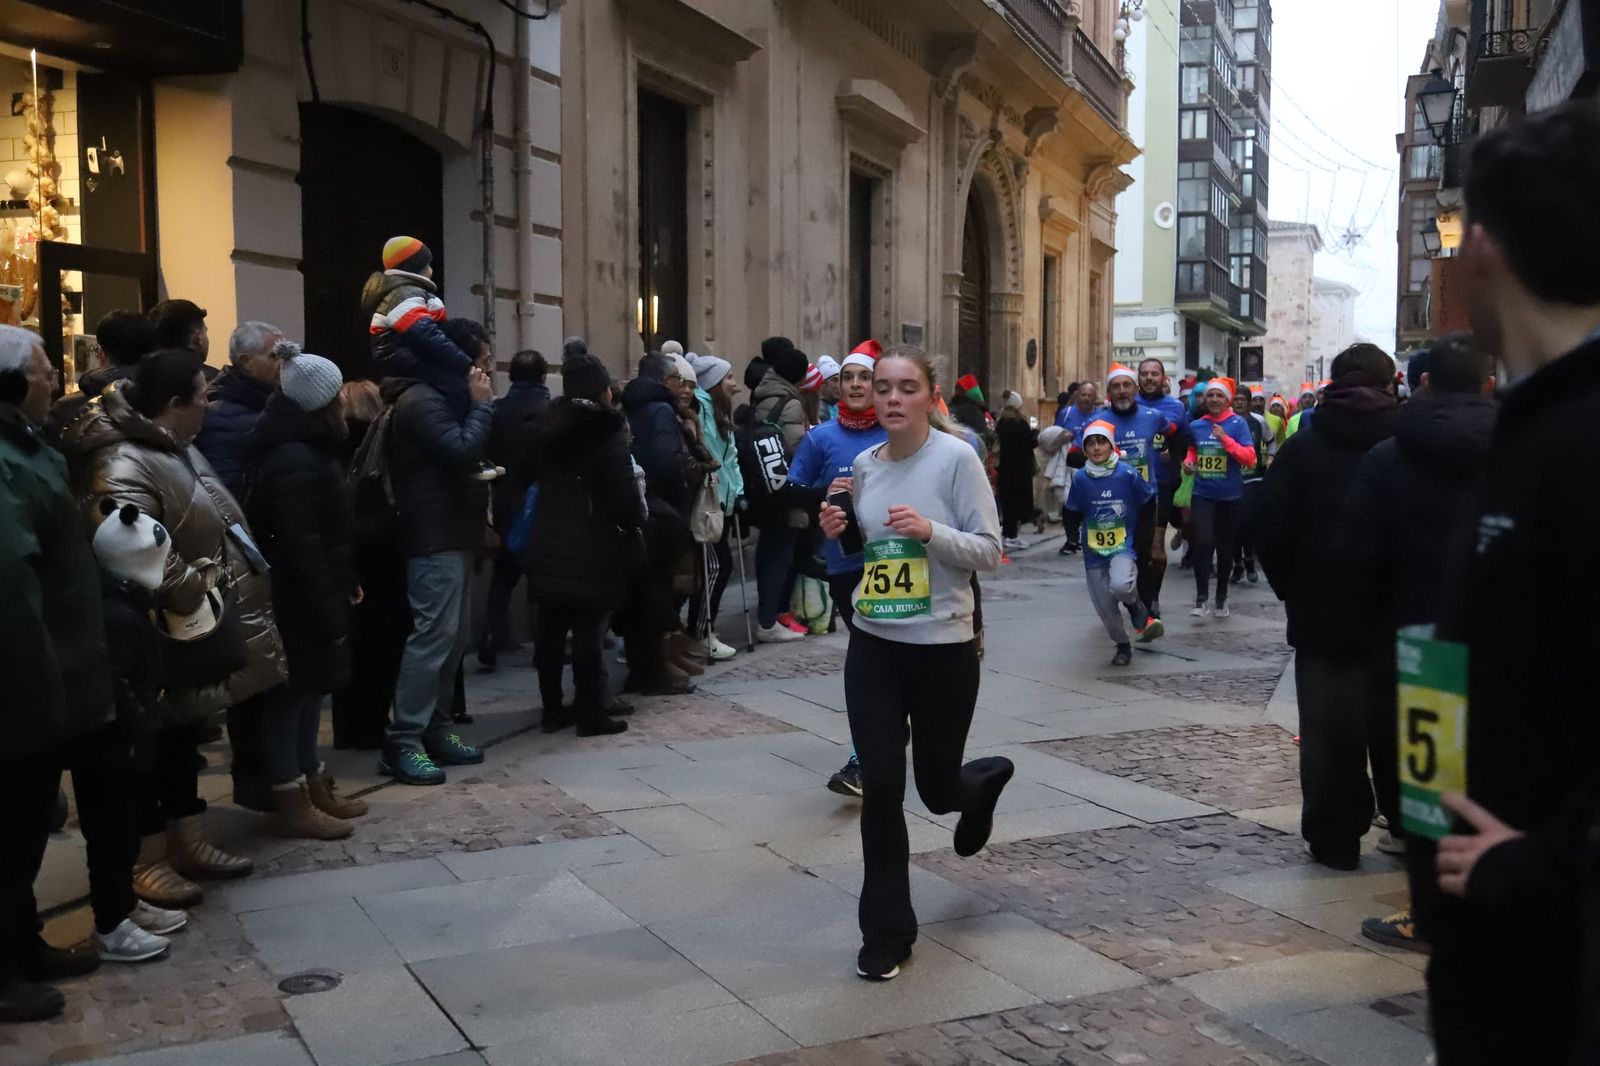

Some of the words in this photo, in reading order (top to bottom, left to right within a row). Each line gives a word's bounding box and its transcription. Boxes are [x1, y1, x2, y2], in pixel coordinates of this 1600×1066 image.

[758, 436, 788, 491] FILA
[1197, 456, 1222, 470] 482
[1101, 490, 1112, 498] 46
[1095, 531, 1116, 547] 93
[896, 602, 927, 612] RURAL
